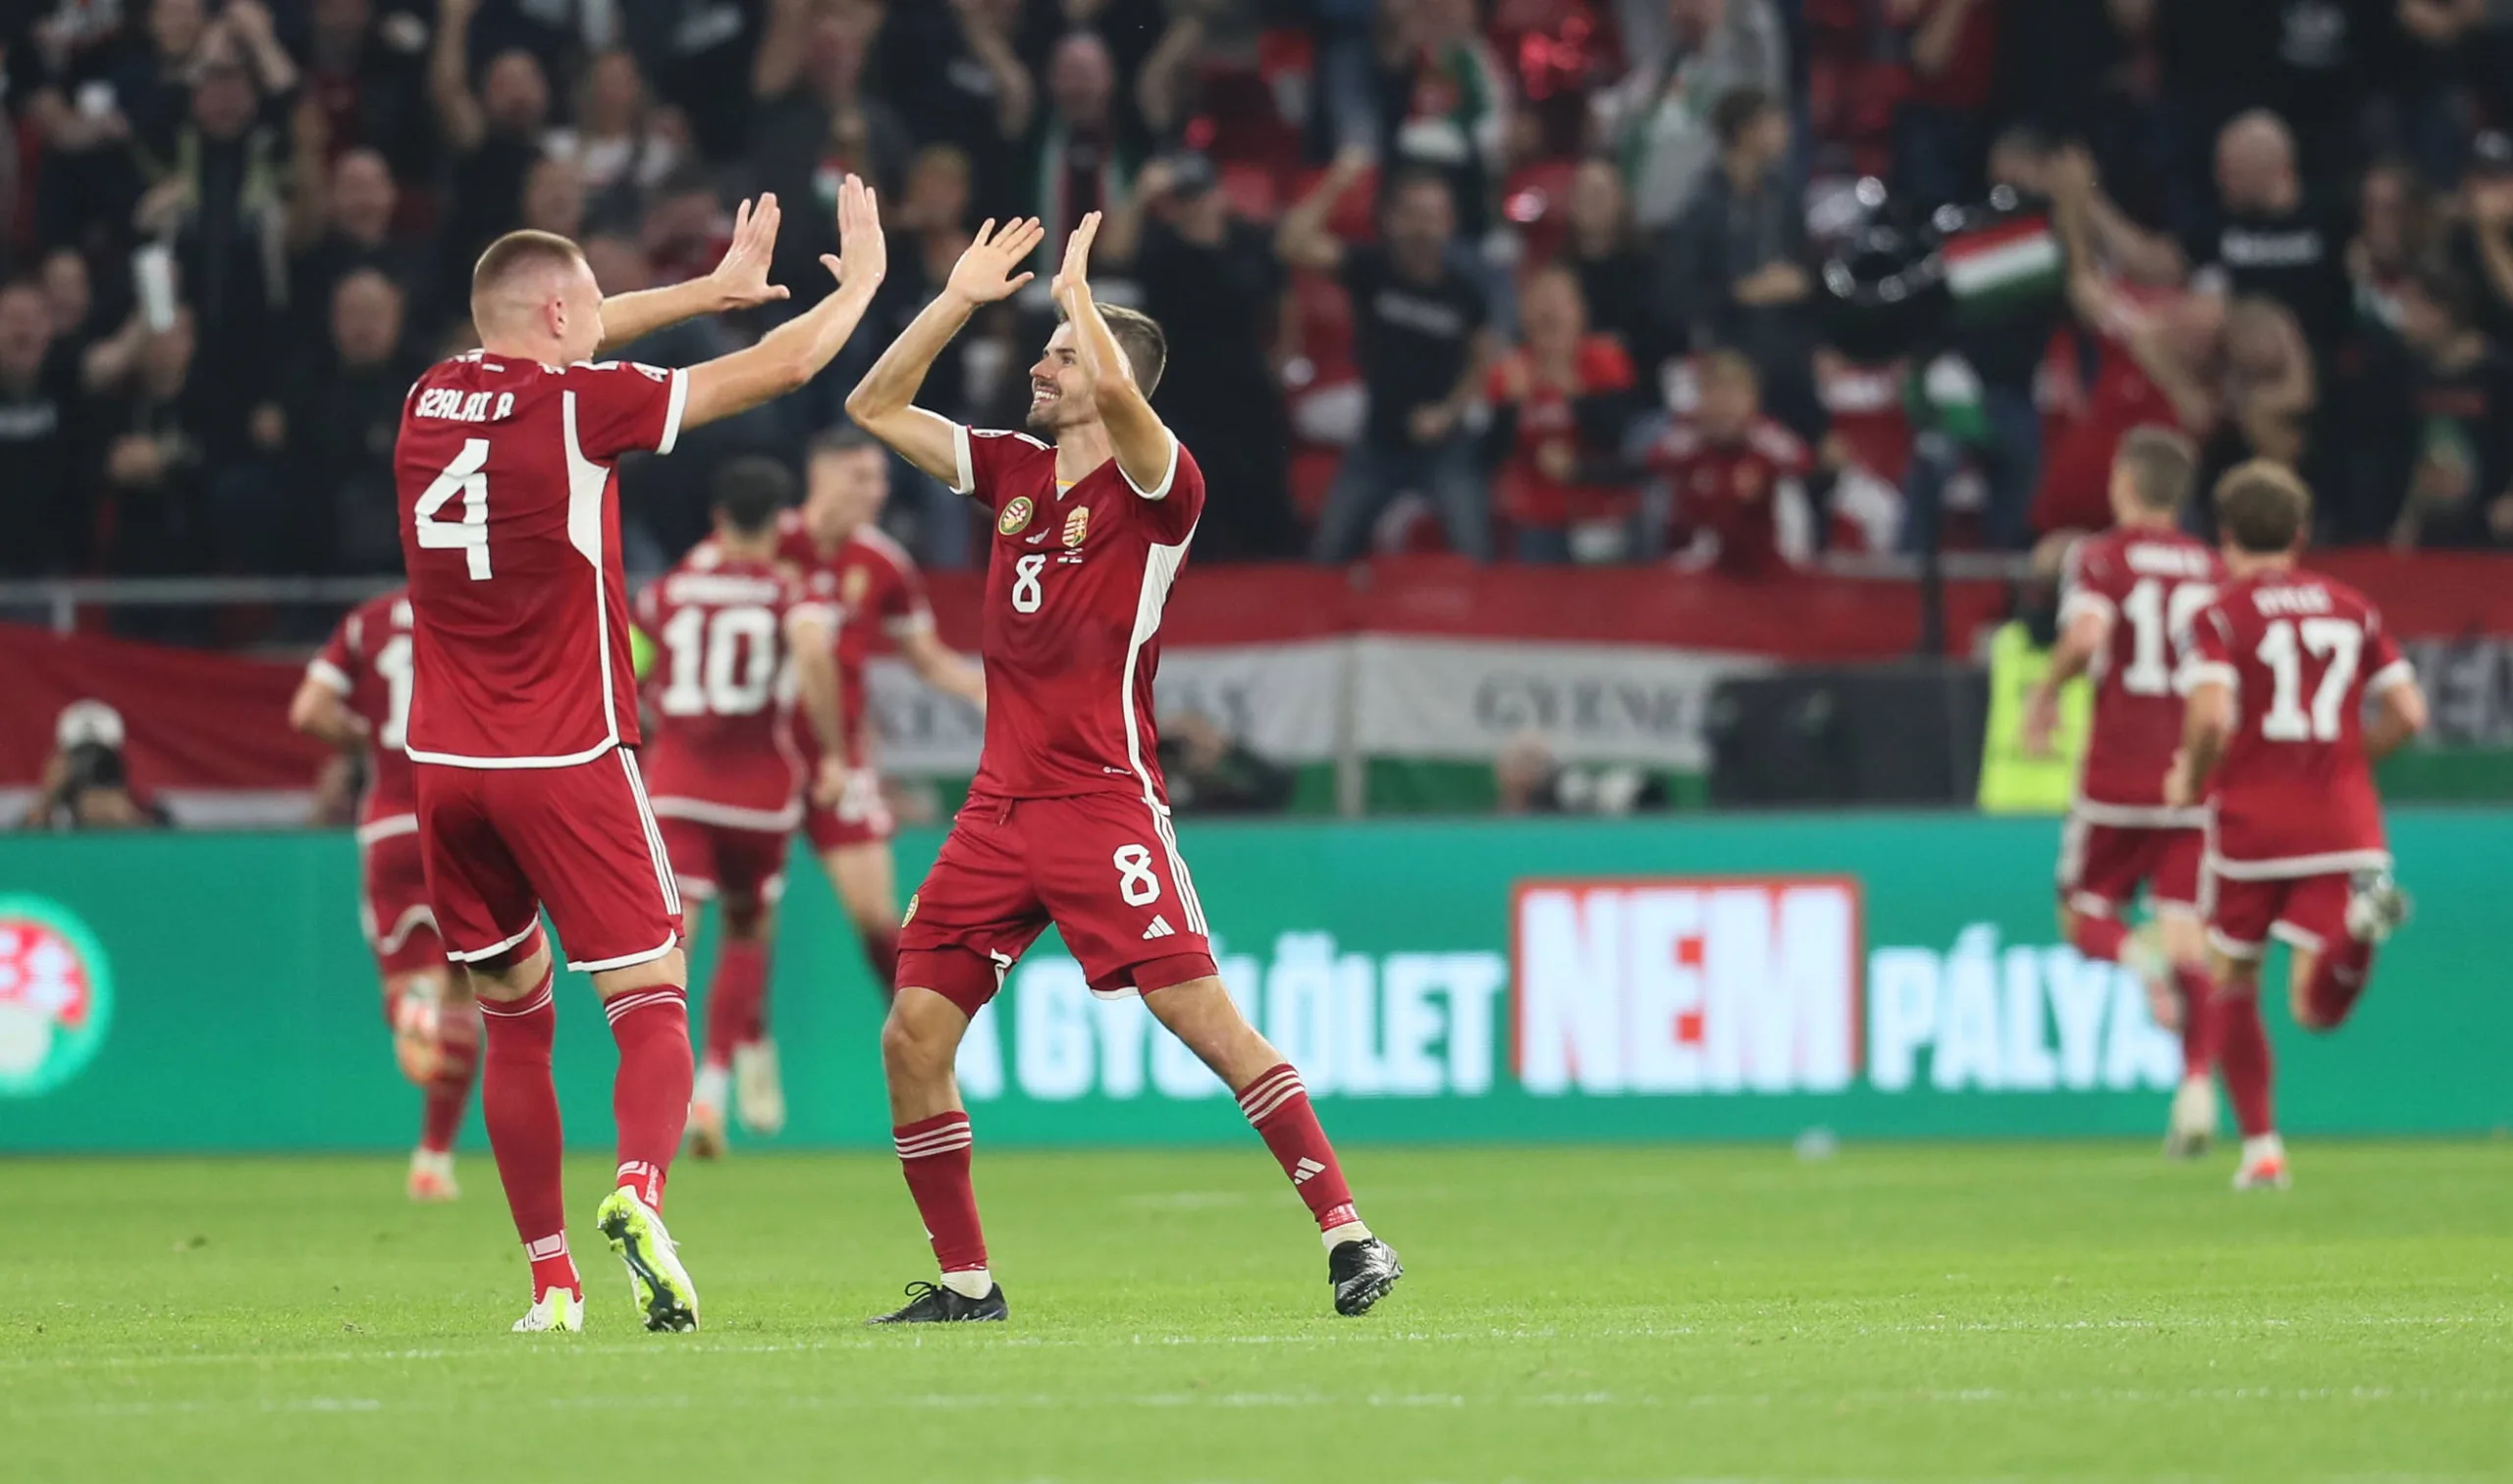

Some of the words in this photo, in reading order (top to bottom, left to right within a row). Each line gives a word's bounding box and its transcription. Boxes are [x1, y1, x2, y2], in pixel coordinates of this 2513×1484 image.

[415, 388, 493, 422] SZALAI
[493, 392, 514, 421] A
[414, 438, 493, 581] 4
[1012, 554, 1046, 613] 8
[660, 606, 776, 716] 10
[2255, 618, 2363, 742] 17
[1112, 843, 1161, 907] 8
[1522, 885, 1853, 1094] NEM
